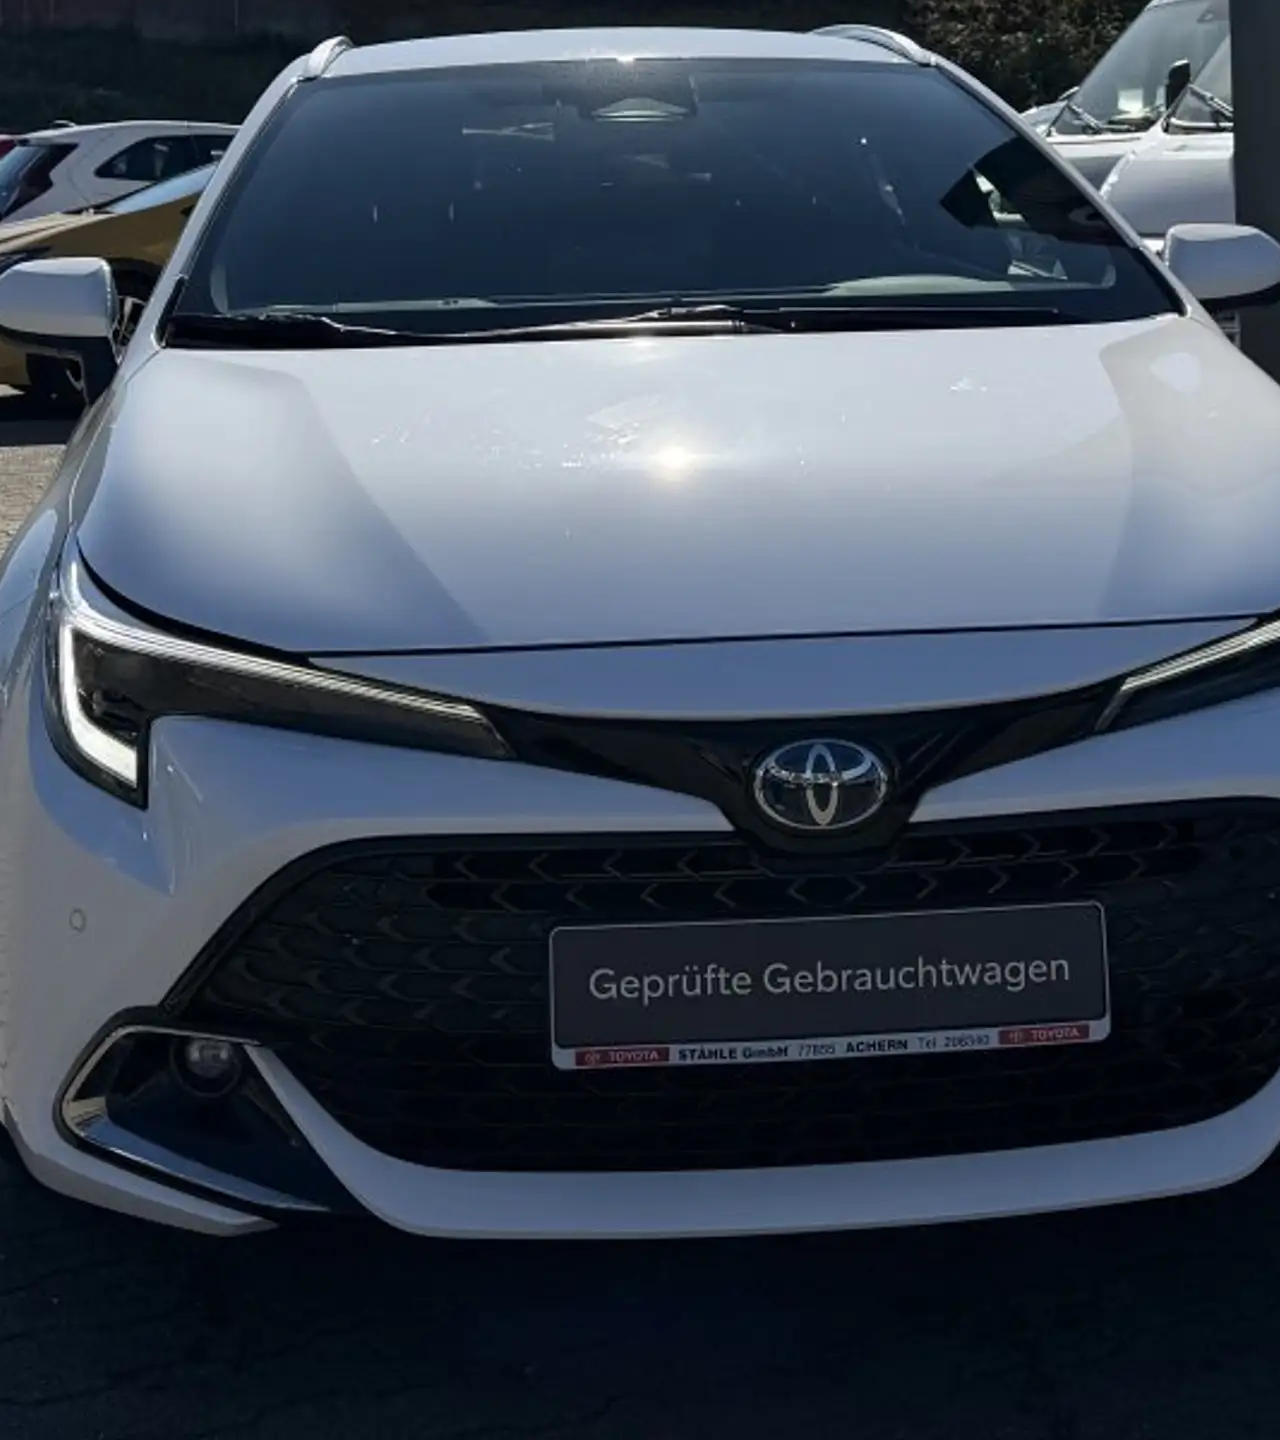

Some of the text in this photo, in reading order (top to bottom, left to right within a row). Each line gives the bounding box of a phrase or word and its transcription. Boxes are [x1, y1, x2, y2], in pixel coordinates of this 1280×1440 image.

[588, 954, 1070, 1008] Geprüfte Gebrauchtwagen
[608, 1049, 659, 1062] TOYOTA
[845, 1038, 908, 1053] ACHERN
[1030, 1027, 1080, 1041] TOYOTA
